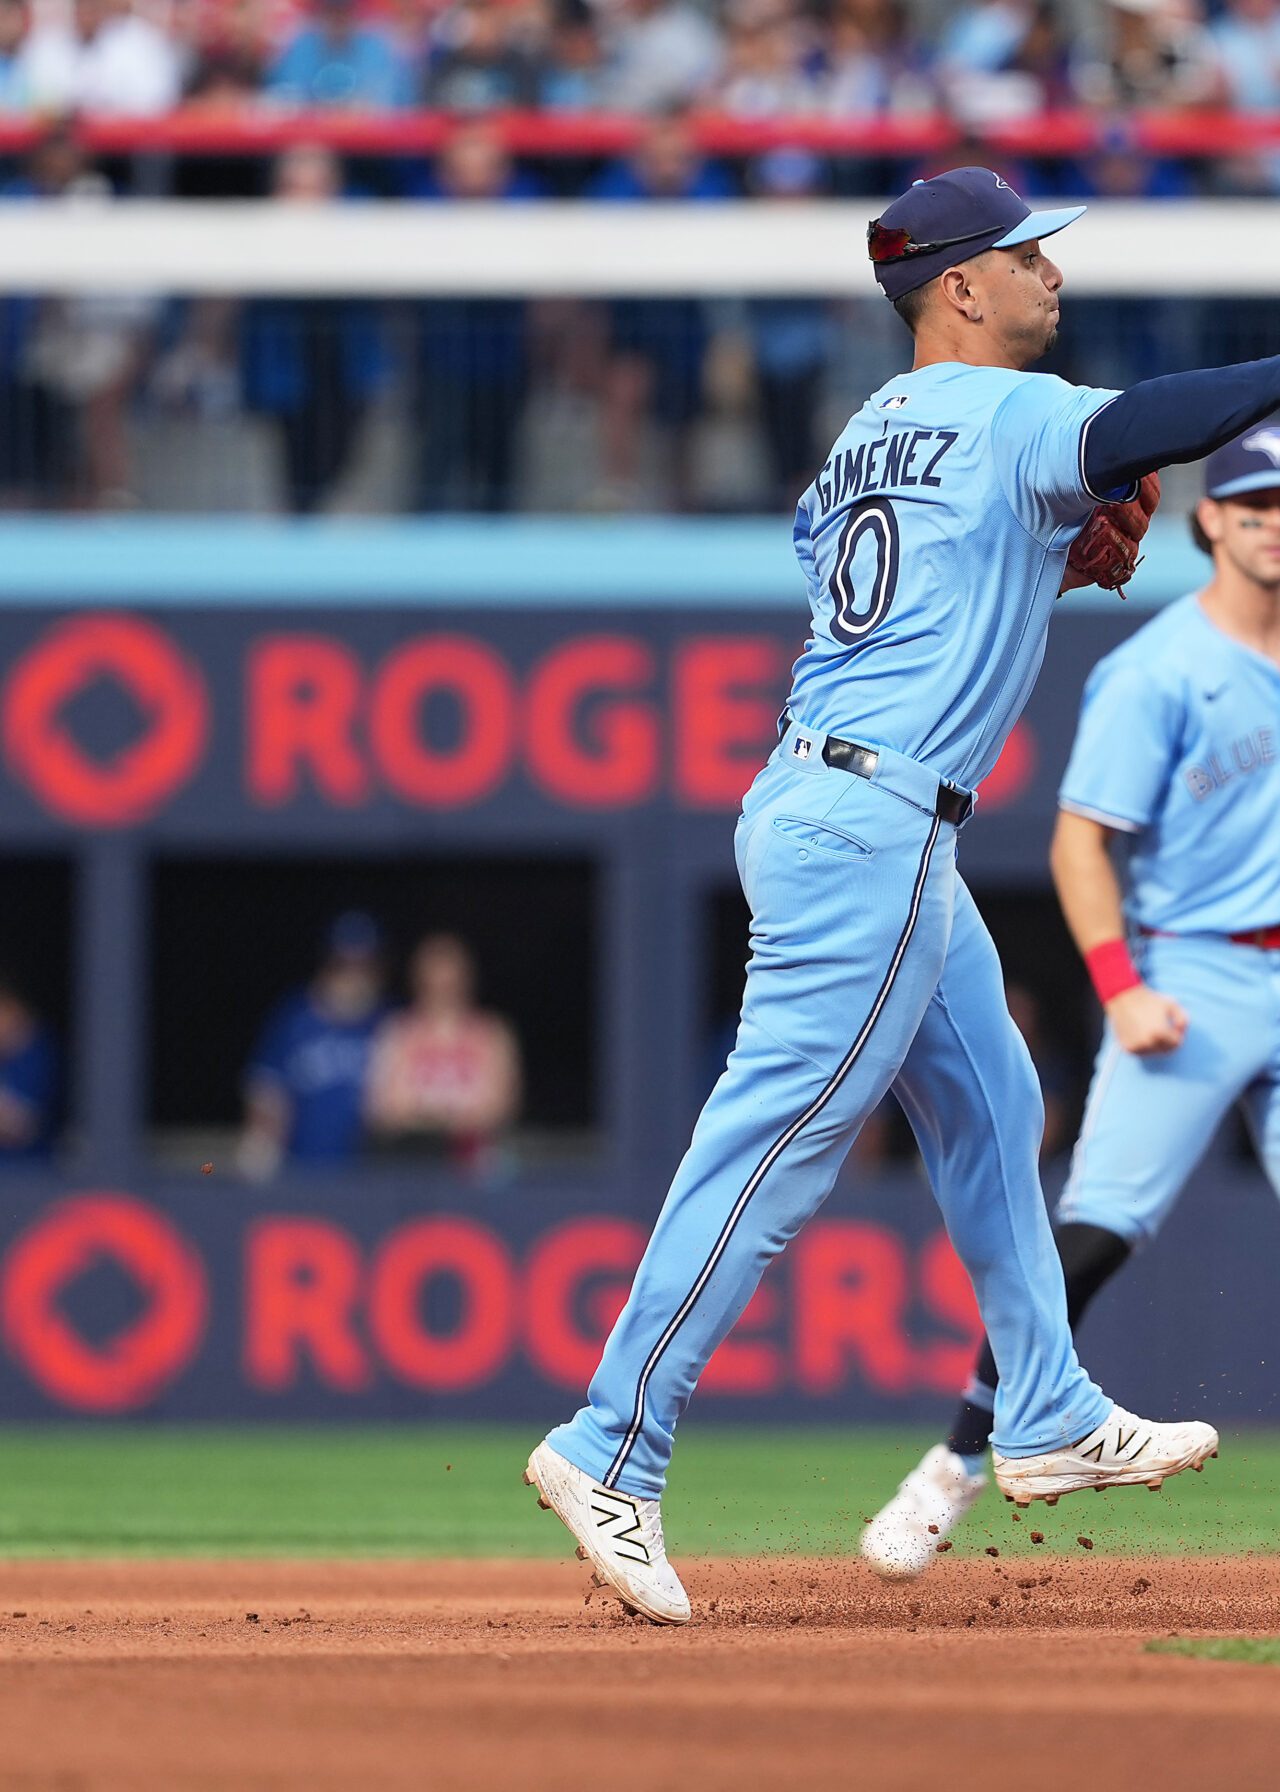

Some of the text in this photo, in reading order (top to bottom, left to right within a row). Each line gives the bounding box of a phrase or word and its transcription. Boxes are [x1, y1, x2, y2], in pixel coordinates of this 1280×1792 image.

[814, 419, 959, 516] GIMÉNEZ
[829, 495, 900, 646] 0
[244, 636, 1036, 808] ROGE
[1184, 725, 1279, 804] BLUE
